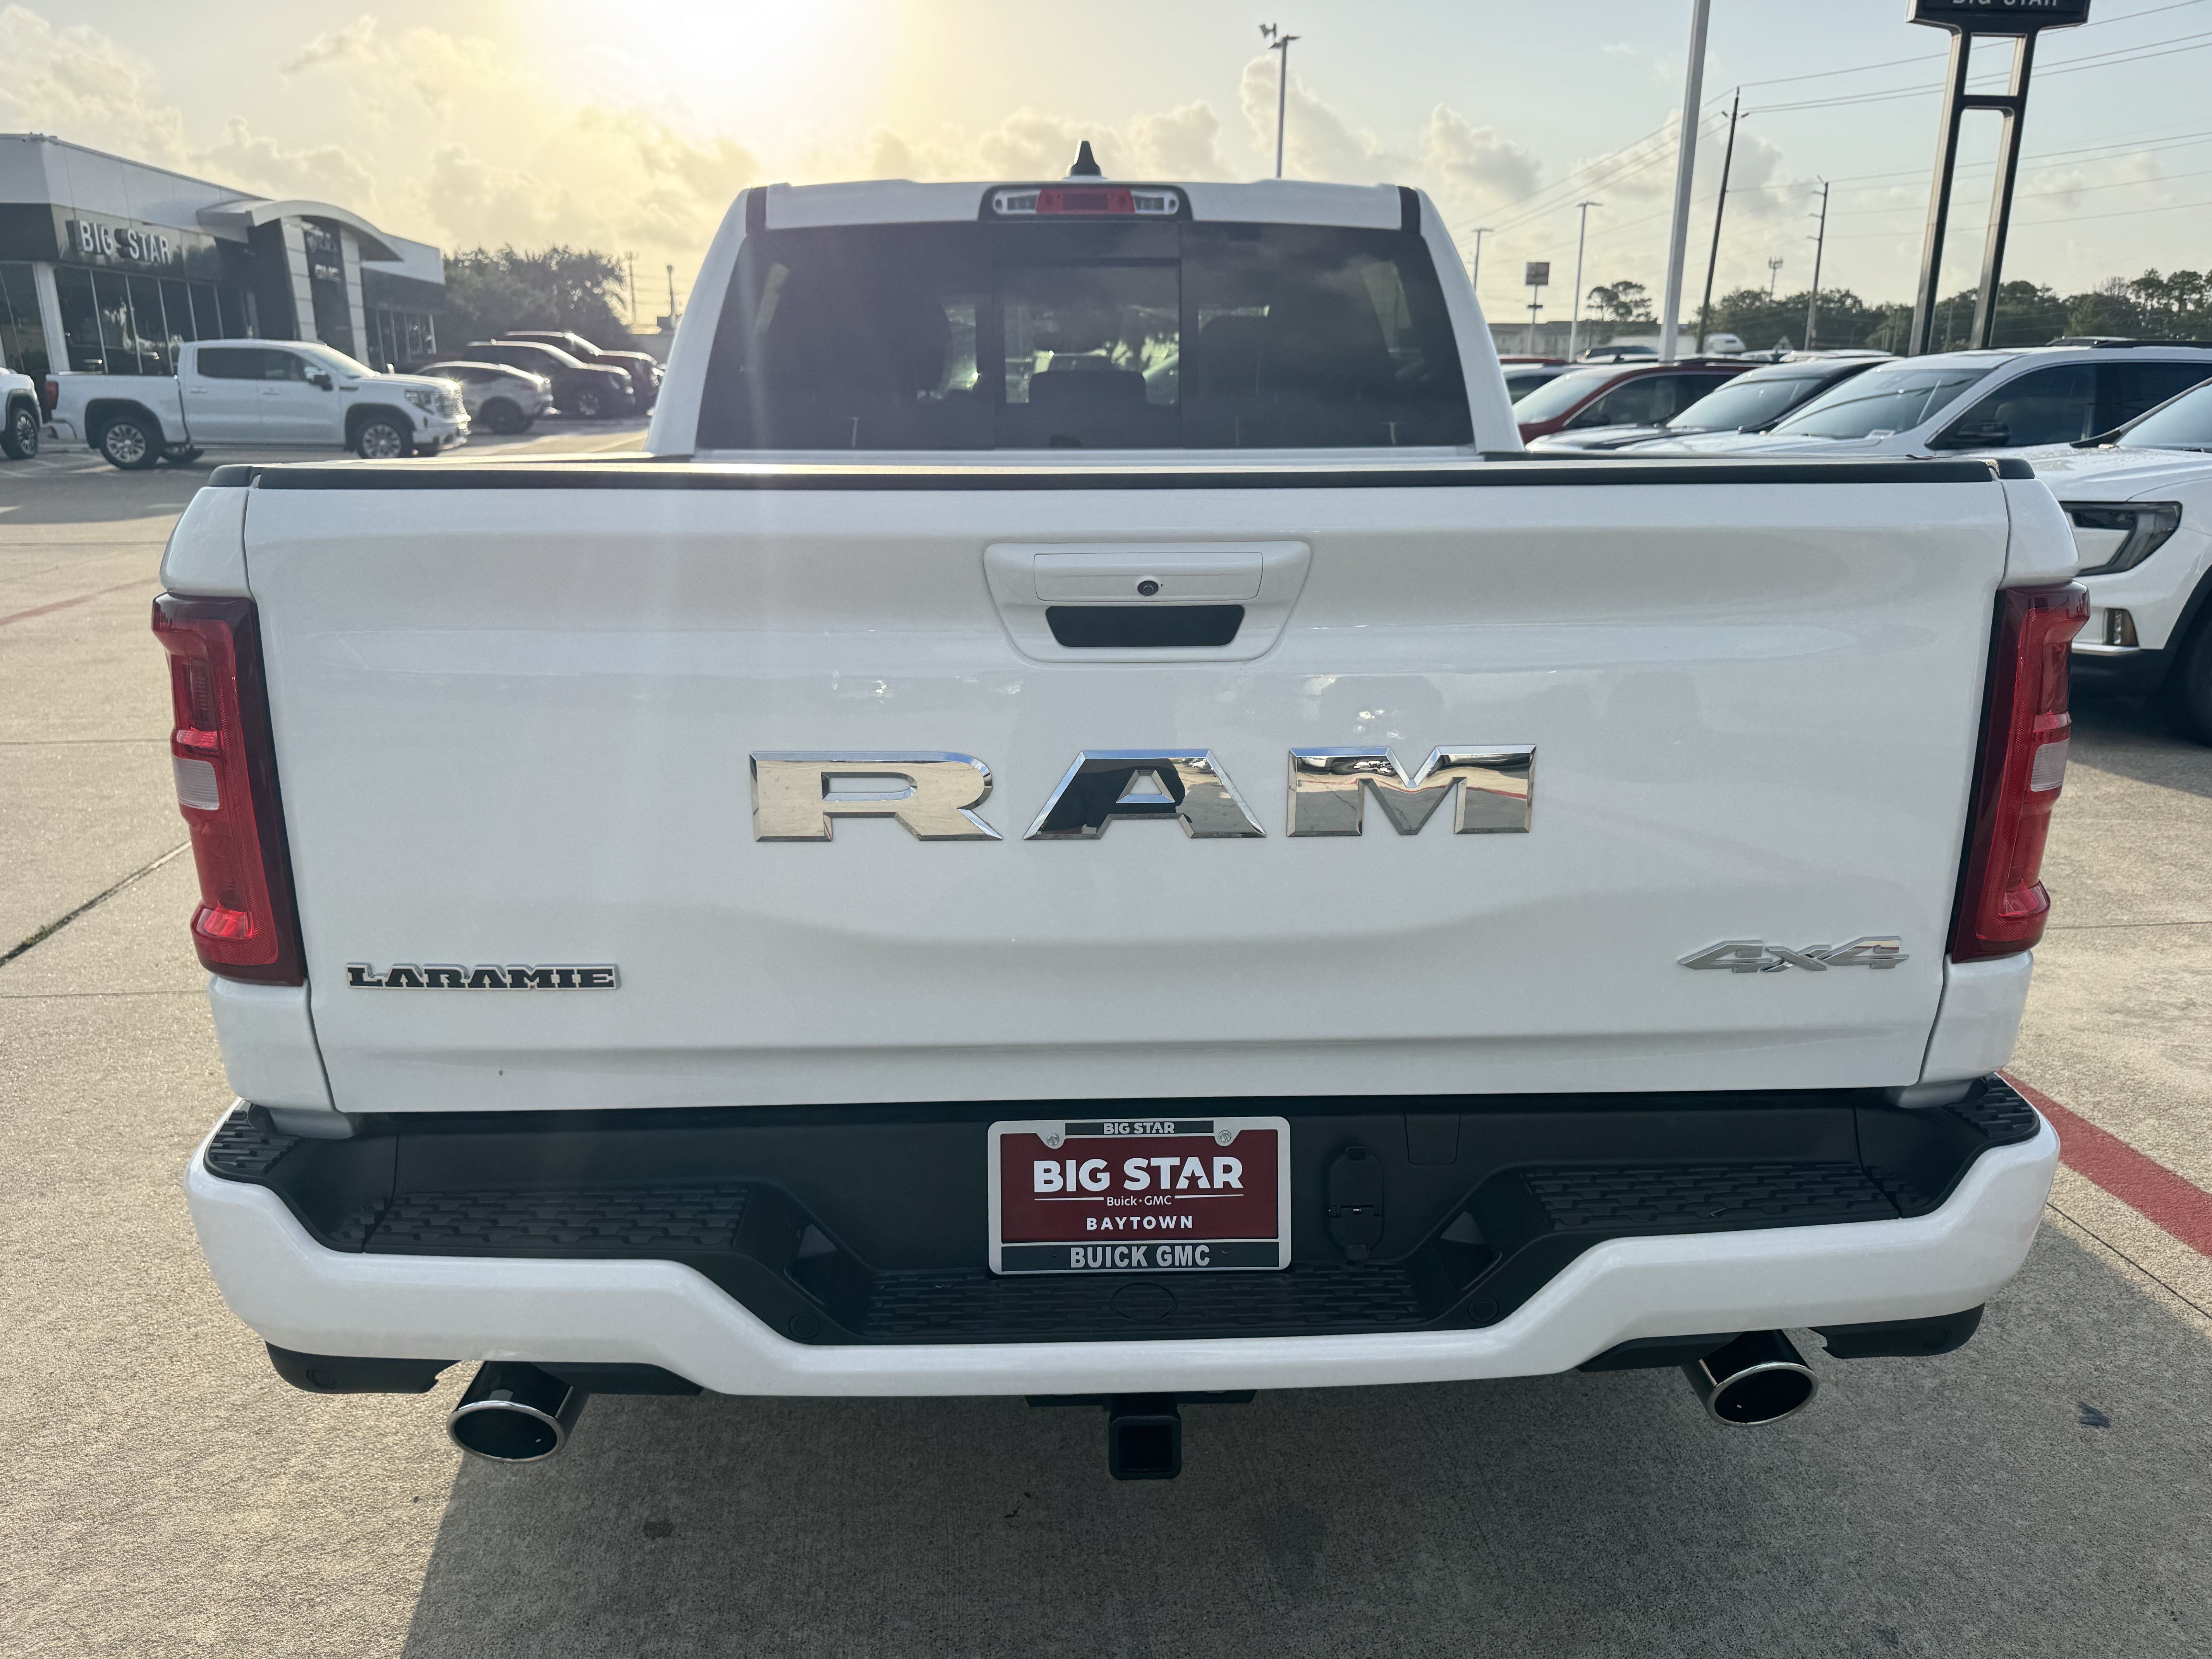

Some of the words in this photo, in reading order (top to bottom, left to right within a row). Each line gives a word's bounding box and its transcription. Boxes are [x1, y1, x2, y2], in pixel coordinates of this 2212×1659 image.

[79, 220, 114, 255] BIG
[128, 228, 172, 265] STAR
[750, 745, 1536, 841] RAM
[346, 963, 620, 990] LARAMIE
[1104, 1123, 1130, 1134] BIG
[1134, 1122, 1175, 1134] STAR
[1034, 1158, 1110, 1192] BIG
[1123, 1156, 1243, 1190] STAR
[1107, 1195, 1137, 1206] Buick
[1144, 1195, 1172, 1205] GMC
[1086, 1215, 1193, 1231] BAYTOWN
[1070, 1246, 1148, 1268] BUICK
[1156, 1245, 1210, 1266] GMC
